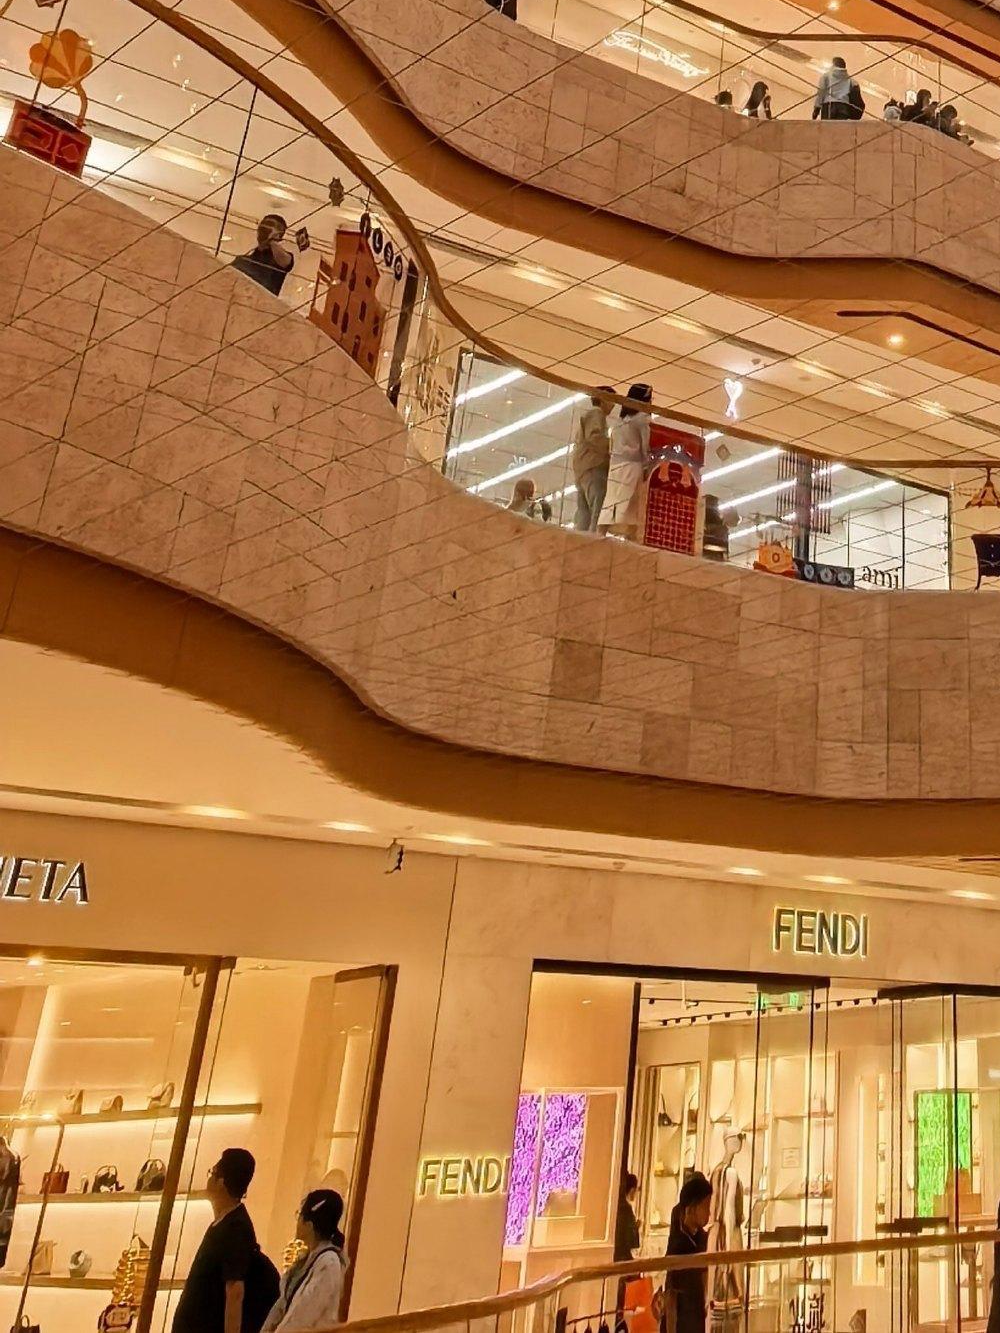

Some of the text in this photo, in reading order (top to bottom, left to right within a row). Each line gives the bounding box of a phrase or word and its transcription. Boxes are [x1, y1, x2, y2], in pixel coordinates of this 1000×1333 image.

[861, 565, 900, 591] ami
[0, 855, 89, 905] ETA
[772, 906, 869, 959] FENDI
[417, 1153, 512, 1198] FENDI
